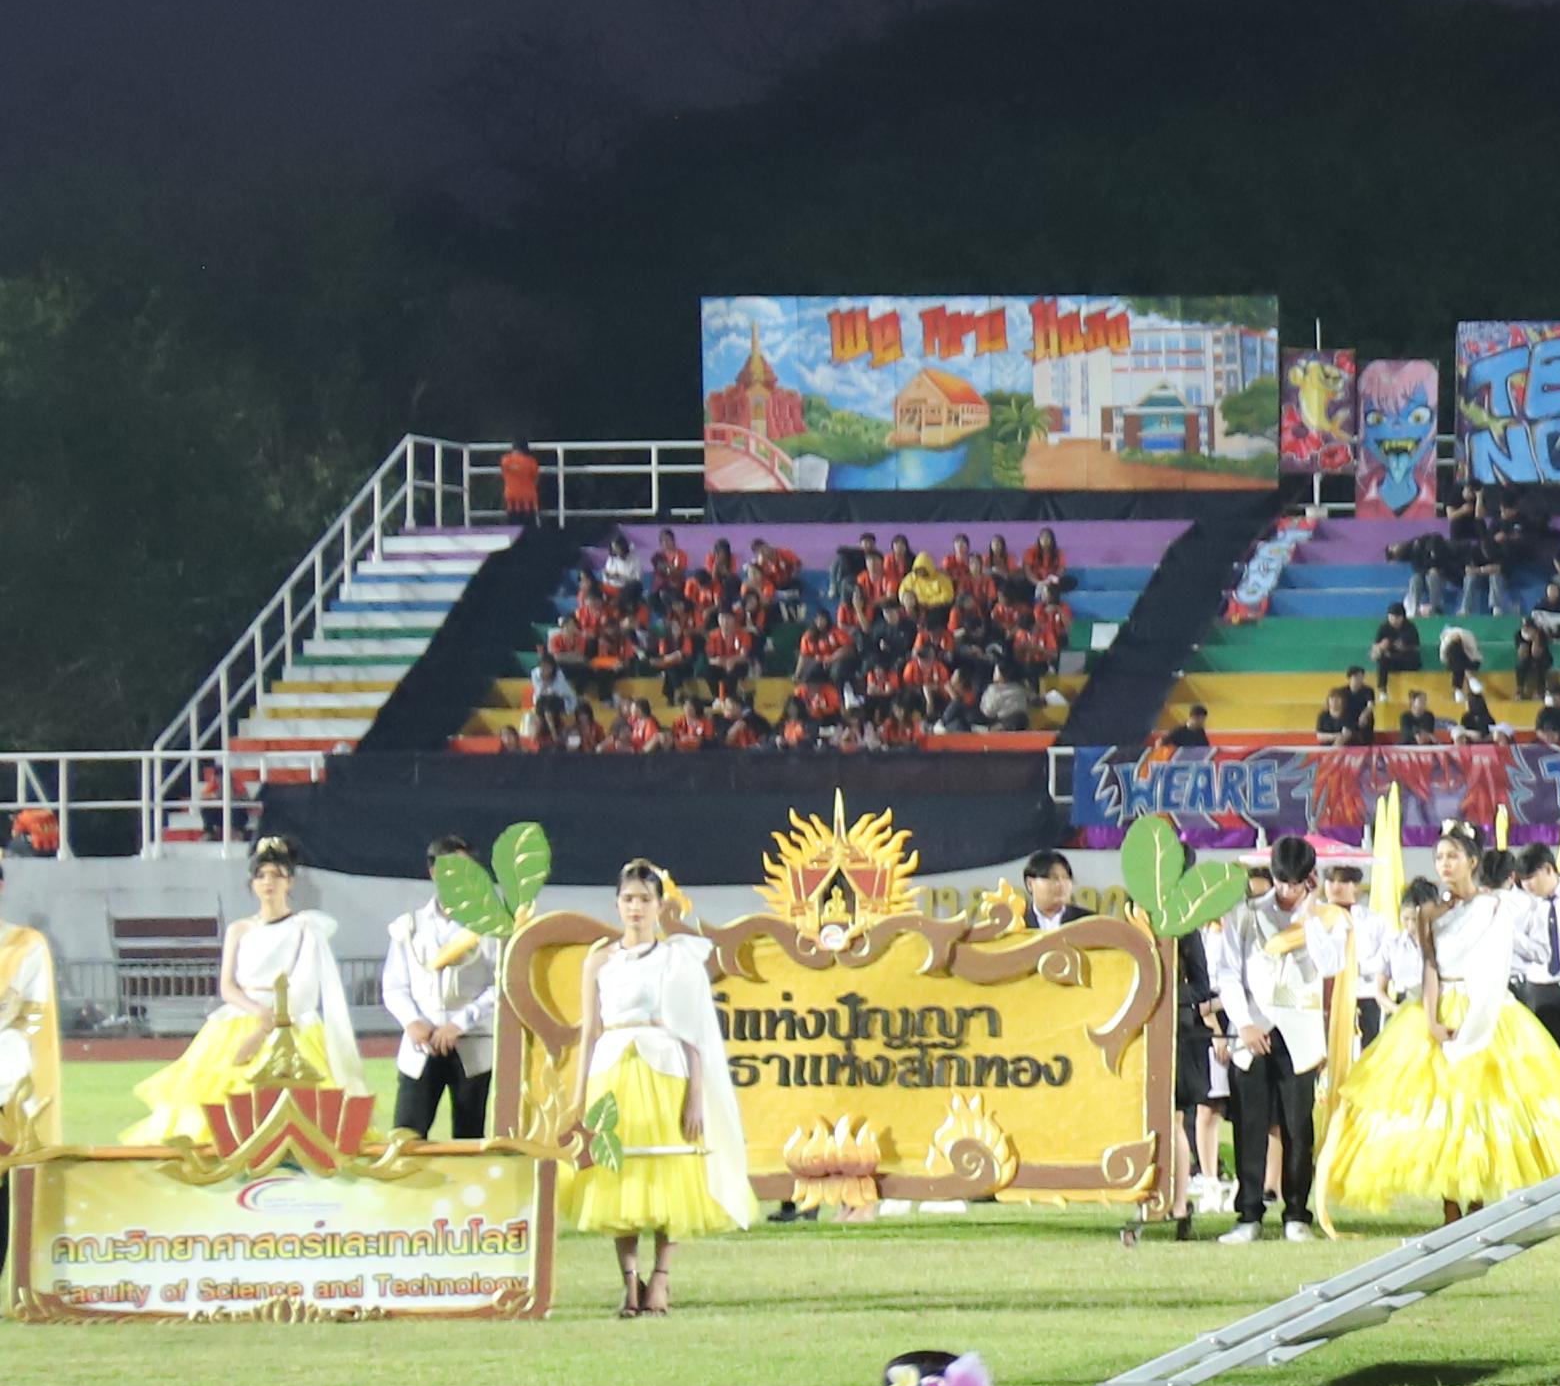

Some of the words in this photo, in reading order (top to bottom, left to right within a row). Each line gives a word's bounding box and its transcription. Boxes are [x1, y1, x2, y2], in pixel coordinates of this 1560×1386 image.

[52, 1217, 529, 1264] คณะวิทยาศาสตร์และเทคโนโลยี
[53, 1281, 151, 1308] Faculty
[160, 1278, 188, 1303] of
[196, 1276, 303, 1301] Science
[313, 1274, 364, 1300] and
